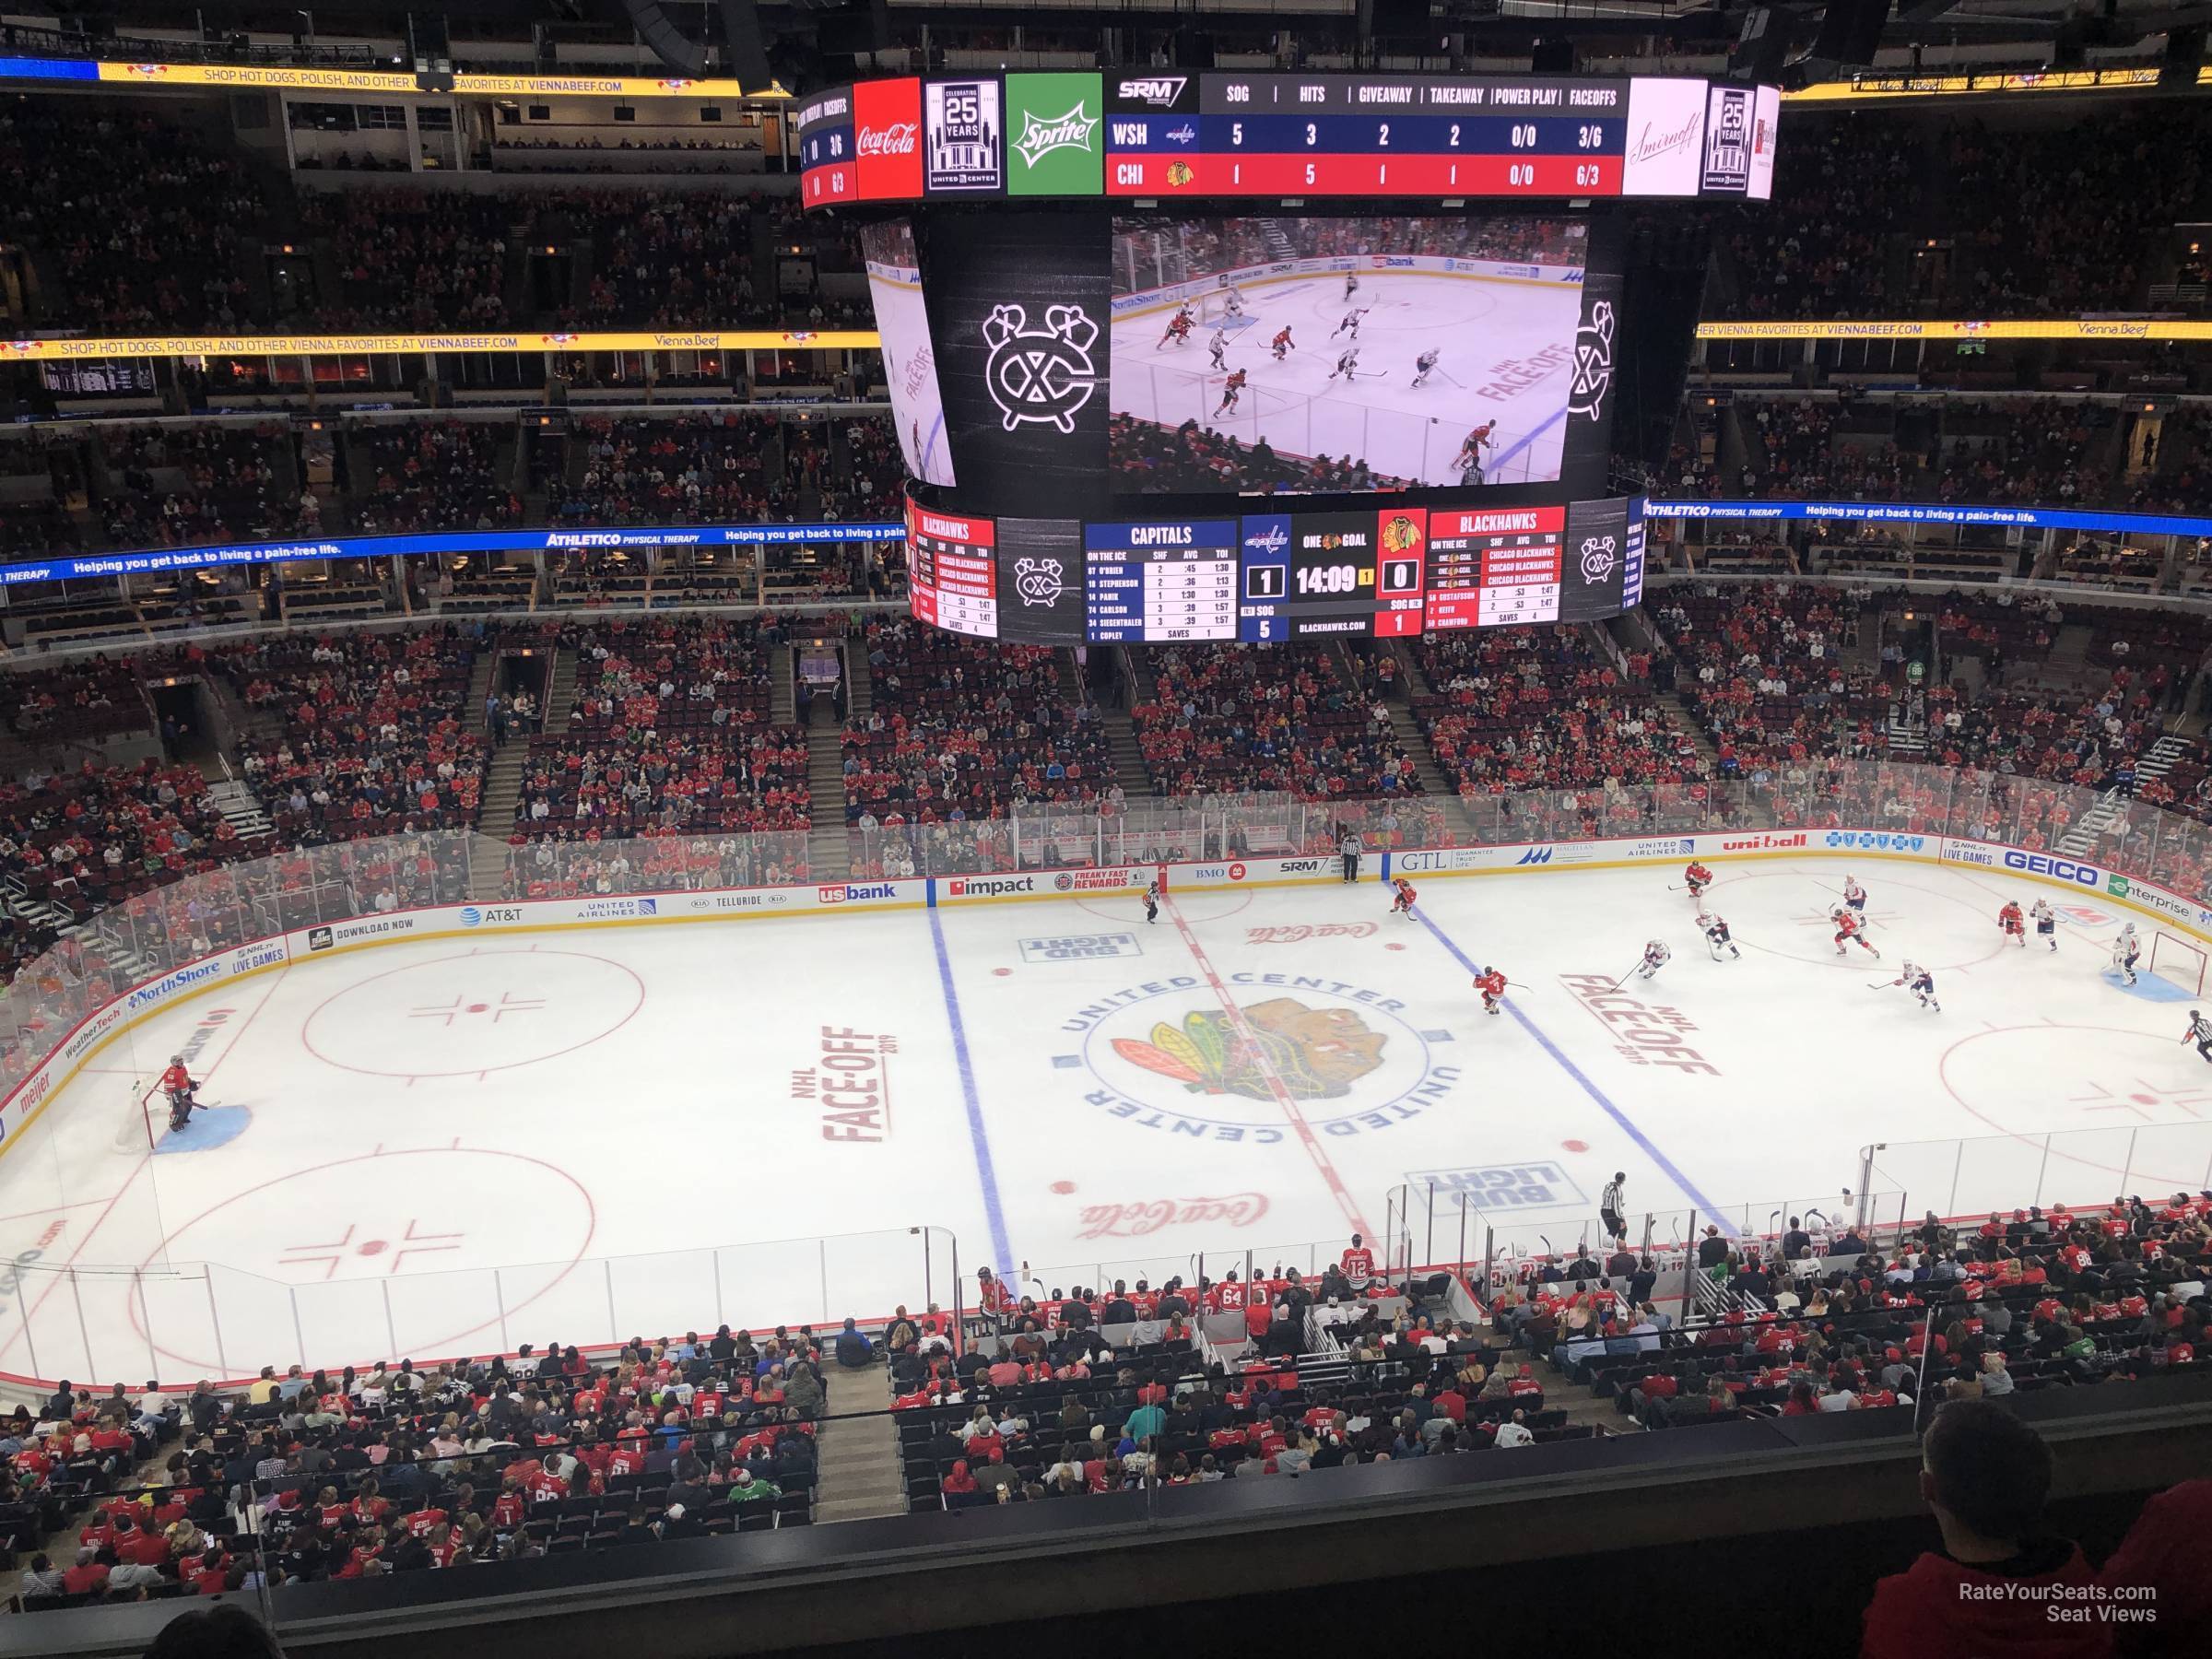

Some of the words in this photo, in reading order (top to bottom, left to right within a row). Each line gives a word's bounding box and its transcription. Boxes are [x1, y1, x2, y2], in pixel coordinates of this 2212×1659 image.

[205, 70, 236, 80] SHOP
[240, 71, 263, 82] HOT
[347, 76, 370, 86] AND
[373, 76, 409, 88] OTHER
[513, 80, 525, 89] AT
[528, 81, 621, 91] VIENNABEEF.COM
[1227, 86, 1249, 102] SOG
[1300, 86, 1325, 102] HITS
[1359, 88, 1413, 102] GIVEAWAY
[1430, 88, 1484, 104] TAKEAWAY
[1495, 89, 1531, 104] POWER
[1533, 89, 1558, 105] PLAY
[1570, 90, 1617, 106] FACEOFFS
[946, 98, 978, 124] 25
[1723, 103, 1743, 128] 25
[947, 125, 978, 136] YEARS
[1023, 120, 1087, 150] Sprite
[1113, 124, 1147, 145] WSH
[1233, 124, 1241, 145] 5
[1307, 124, 1316, 145] 3
[1380, 124, 1389, 146] 2
[1451, 124, 1459, 146] 2
[1512, 125, 1536, 147] 0/0
[1579, 125, 1603, 148] 3/6
[1630, 112, 1701, 165] Smirnoff
[1722, 130, 1740, 140] YEARS
[1117, 165, 1143, 184] CHI
[1306, 164, 1315, 184] 5
[1510, 164, 1534, 186] 0/0
[1577, 165, 1599, 186] 6/3
[1718, 325, 1753, 335] VIENNA
[1757, 325, 1809, 335] FAVORITES
[1828, 325, 1922, 334] VIENNABEEF.COM
[61, 342, 95, 354] SHOP
[100, 343, 124, 353] HOT
[218, 341, 243, 351] AND
[247, 341, 286, 350] OTHER
[290, 339, 333, 350] VIENNA
[337, 339, 398, 349] FAVORITES
[402, 338, 415, 348] AT
[418, 338, 517, 348] VIENNABEEF.COM
[1806, 505, 1843, 516] Helping
[1846, 509, 1865, 517] you
[1867, 509, 1884, 518] get
[1887, 509, 1911, 517] back
[1912, 509, 1924, 518] to
[1926, 509, 1954, 520] living
[1966, 512, 2015, 521] pain-free
[1460, 513, 1536, 533] BLACKHAWKS
[547, 534, 621, 546] ATHLETICO
[725, 531, 765, 541] Helping
[767, 532, 785, 541] you
[788, 530, 805, 540] get
[807, 529, 830, 537] back
[833, 529, 843, 537] to
[846, 528, 873, 538] living
[1131, 527, 1192, 545] CAPITALS
[1303, 536, 1322, 547] ONE
[1342, 535, 1366, 546] GOAL
[1442, 540, 1454, 548] THE
[1517, 536, 1530, 545] AVG
[74, 563, 123, 573] Helping
[125, 560, 147, 571] you
[151, 556, 174, 568] get
[173, 554, 202, 564] back
[205, 553, 217, 561] to
[219, 551, 252, 560] living
[265, 547, 317, 559] pain-free
[1100, 552, 1113, 560] THE
[1115, 552, 1126, 560] ICE
[1489, 550, 1514, 559] CHICAGO
[1516, 548, 1555, 559] BLACKHAWKS
[1489, 563, 1514, 572] CHICAGO
[1515, 560, 1554, 571] BLACKHAWKS
[6, 570, 50, 582] THERAPY
[1261, 571, 1270, 594] 1
[1297, 565, 1356, 594] 14:09
[1394, 564, 1406, 587] 0
[1488, 576, 1513, 584] CHICAGO
[1515, 573, 1553, 583] BLACKHAWKS
[1257, 606, 1274, 616] SOG
[1391, 600, 1407, 610] SOG
[1395, 615, 1402, 631] 1
[1499, 614, 1518, 622] SAVES
[1260, 621, 1270, 638] 5
[1300, 622, 1365, 632] BLACKHAWKS.COM
[1724, 834, 1806, 851] uni-ball
[1402, 853, 1446, 871] GTL
[1944, 849, 1961, 860] LIVE
[1963, 852, 1993, 865] GAMES
[1196, 869, 1224, 877] BMO
[1280, 861, 1318, 873] SRM
[2005, 851, 2098, 886] GEICO
[1075, 872, 1106, 880] FREAKY
[1075, 877, 1128, 889] REWARDS
[965, 877, 1033, 896] impact
[717, 896, 761, 907] TELLURIDE
[2111, 880, 2190, 917] enterprise
[486, 909, 523, 922] AT&T
[577, 910, 635, 918] AIRLINES
[336, 923, 389, 939] DOWNLOAD
[392, 919, 413, 929] NOW
[1029, 935, 1130, 950] LIGHT
[1045, 946, 1121, 959] BUD
[232, 959, 252, 973] LIVE
[253, 949, 283, 967] GAMES
[137, 962, 219, 1001] NorthShore
[1061, 975, 1197, 1034] UNITED
[1230, 971, 1406, 1015] CENTER
[1559, 974, 1723, 1077] FACE-OFF
[1651, 1006, 1700, 1033] NHL
[65, 1006, 120, 1060] WeatherTech
[877, 1035, 899, 1053] 2019
[791, 1067, 816, 1099] NHL
[821, 1026, 883, 1142] FACE-OFF
[19, 1071, 51, 1113] meijer
[1324, 1065, 1463, 1137] UNITED
[1083, 1088, 1284, 1145] CENTER
[1423, 1166, 1561, 1192] LIGHT
[1452, 1185, 1557, 1207] BUD
[2076, 1252, 2092, 1267] 88
[1351, 1261, 1366, 1277] 12
[1223, 1289, 1241, 1305] 64
[415, 1521, 429, 1529] GEIST
[505, 1511, 511, 1524] 1
